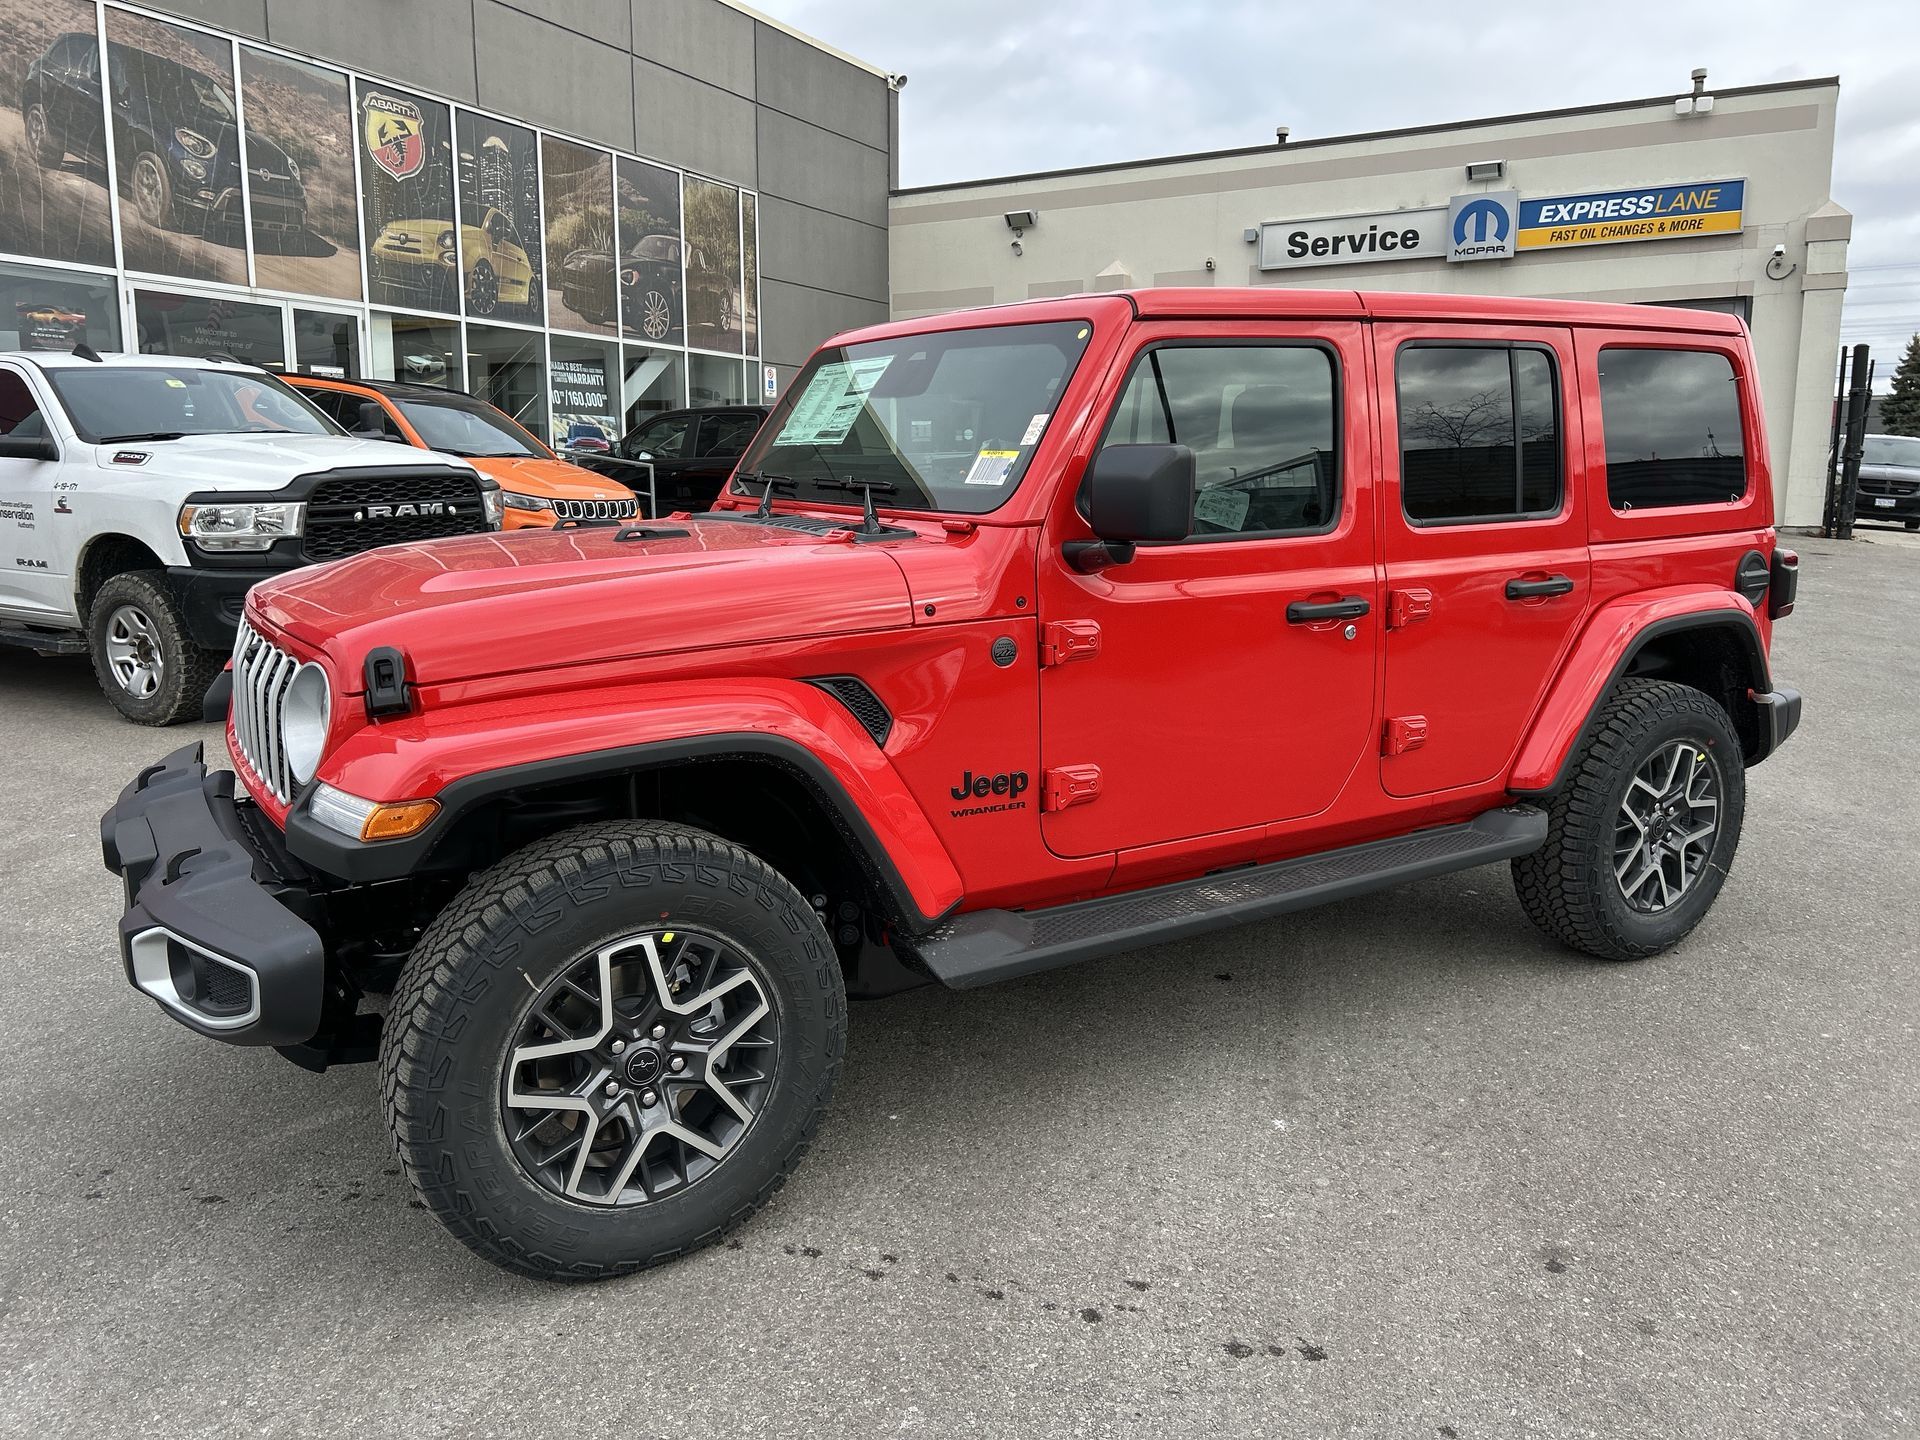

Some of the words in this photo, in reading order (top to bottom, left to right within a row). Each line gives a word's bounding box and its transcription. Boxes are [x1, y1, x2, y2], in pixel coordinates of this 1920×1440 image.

[370, 99, 416, 118] ABARTH
[1550, 229, 1578, 242] FAST
[1580, 228, 1597, 240] OIL
[1600, 223, 1653, 238] CHANGES
[1658, 221, 1666, 234] &
[1669, 218, 1704, 231] MORE
[1287, 225, 1420, 258] Service
[1454, 245, 1506, 257] MOPAR
[194, 326, 228, 338] Welcome
[230, 330, 238, 338] to
[180, 335, 193, 344] The
[223, 340, 244, 349] Home
[245, 342, 253, 350] of
[567, 373, 604, 386] WARRANTY
[117, 452, 145, 460] 3500
[367, 502, 444, 519] RAM
[16, 558, 48, 569] RAM
[950, 770, 1029, 801] Jeep
[950, 801, 1026, 818] WRANGLER
